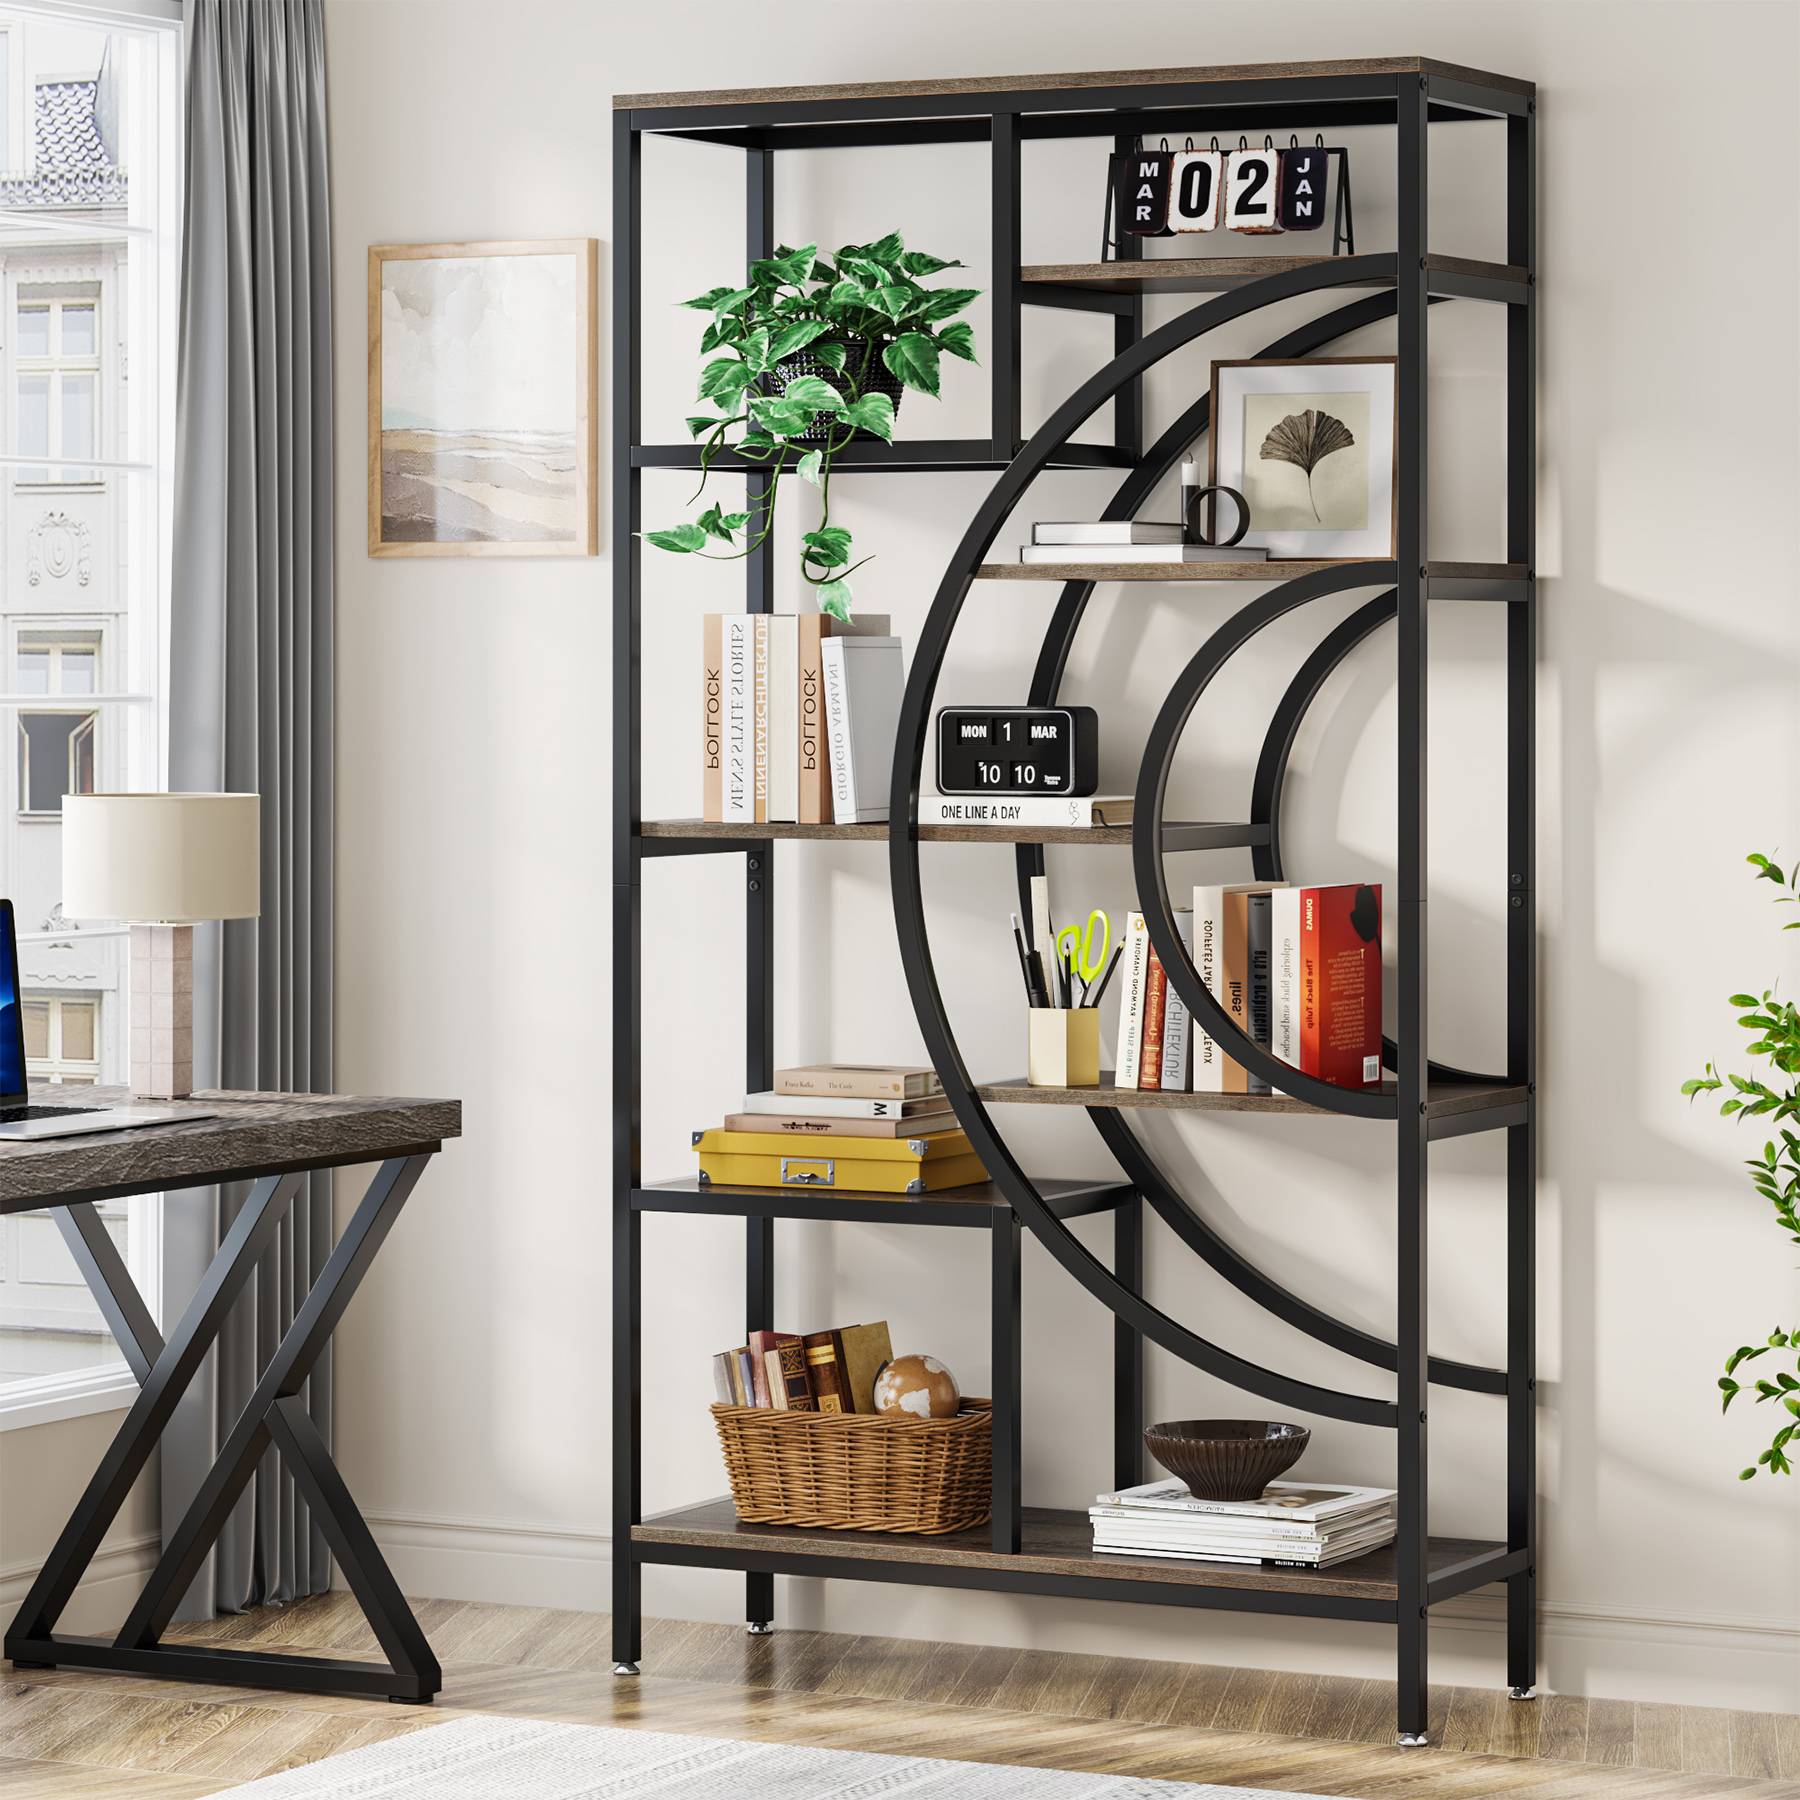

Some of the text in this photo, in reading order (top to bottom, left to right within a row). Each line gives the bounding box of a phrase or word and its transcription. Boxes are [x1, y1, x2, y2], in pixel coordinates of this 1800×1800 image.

[1136, 162, 1159, 221] MAR
[1295, 157, 1313, 217] JAN
[961, 722, 1057, 741] MON 1 MAR
[980, 765, 1000, 783] 10
[1015, 765, 1035, 783] 10
[941, 805, 1021, 819] ONE LINE A DAY
